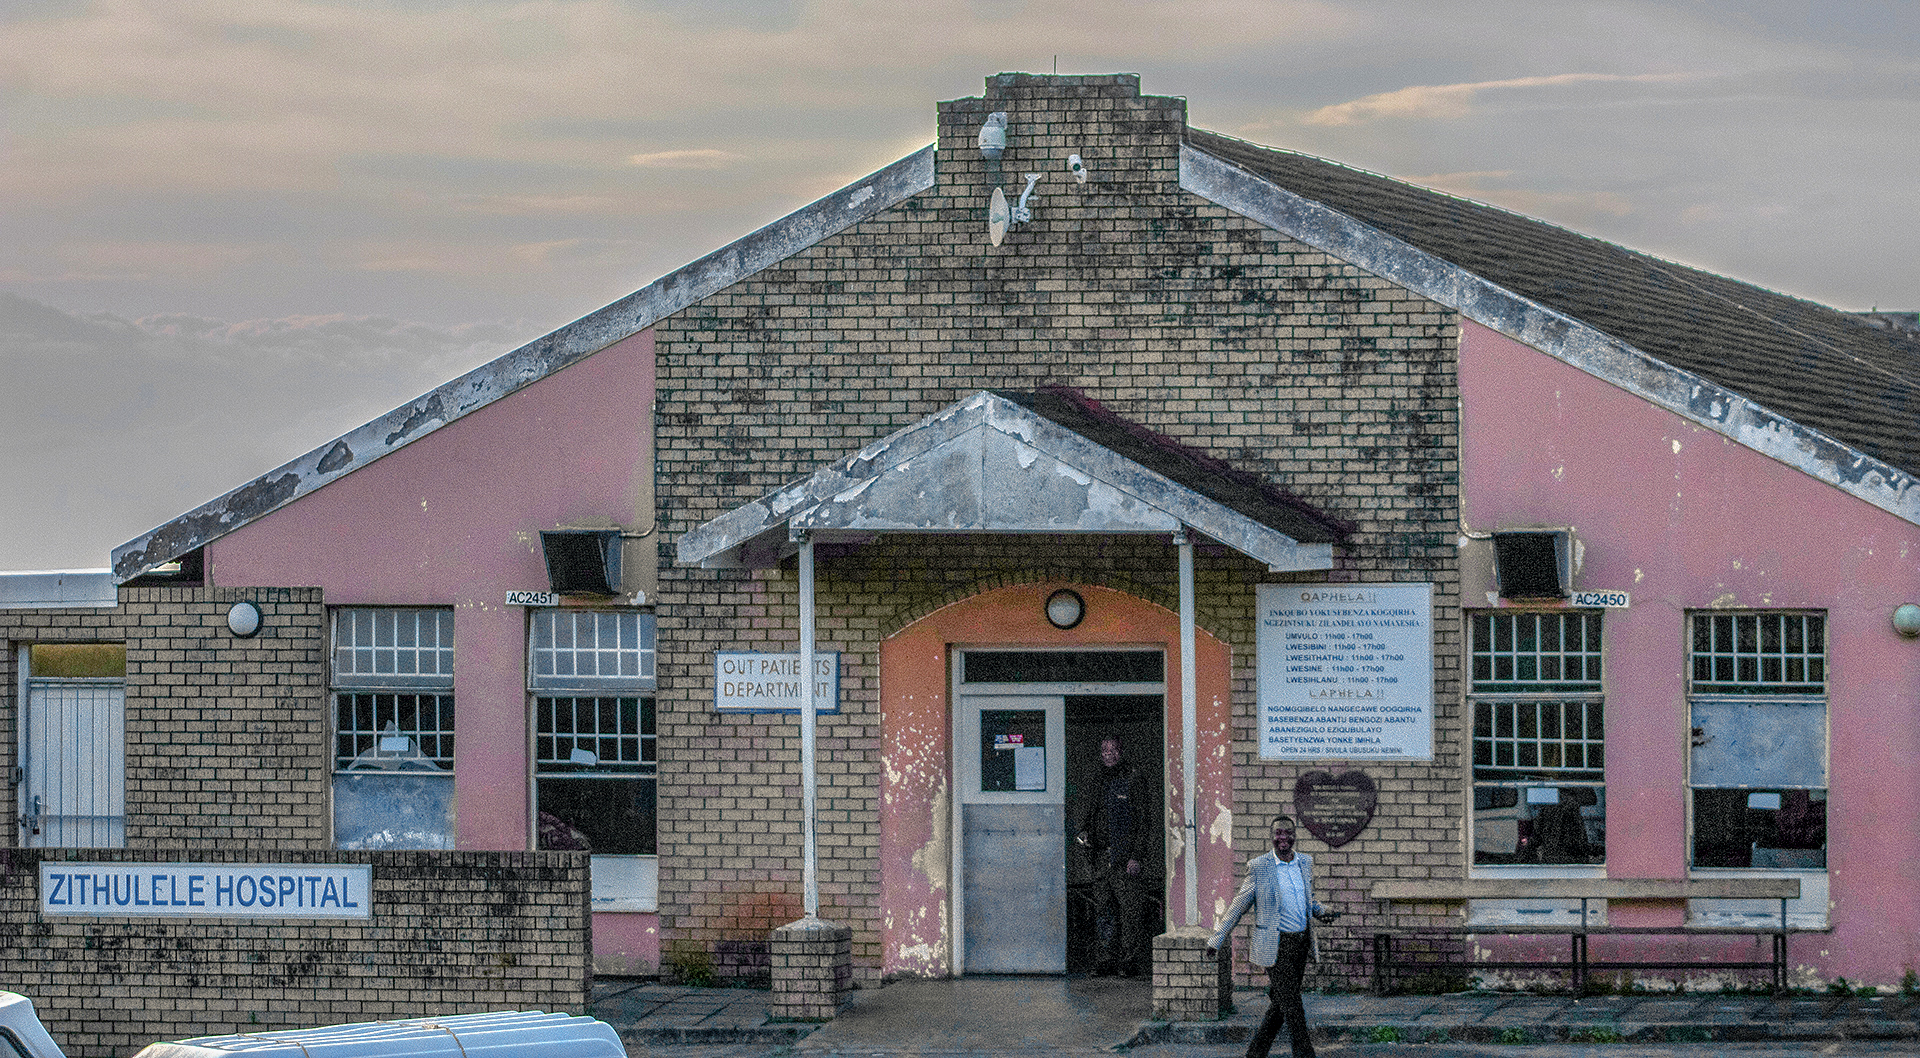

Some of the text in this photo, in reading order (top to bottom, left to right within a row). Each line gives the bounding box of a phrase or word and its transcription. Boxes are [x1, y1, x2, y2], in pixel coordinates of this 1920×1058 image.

[509, 592, 552, 603] AC2451
[1301, 592, 1364, 602] QAPHELA
[1576, 593, 1625, 606] AC2450
[724, 660, 830, 675] OUT PATIETS
[724, 682, 829, 697] DEPARTMNT
[49, 874, 358, 908] ZITHULELE HOSPITAL
